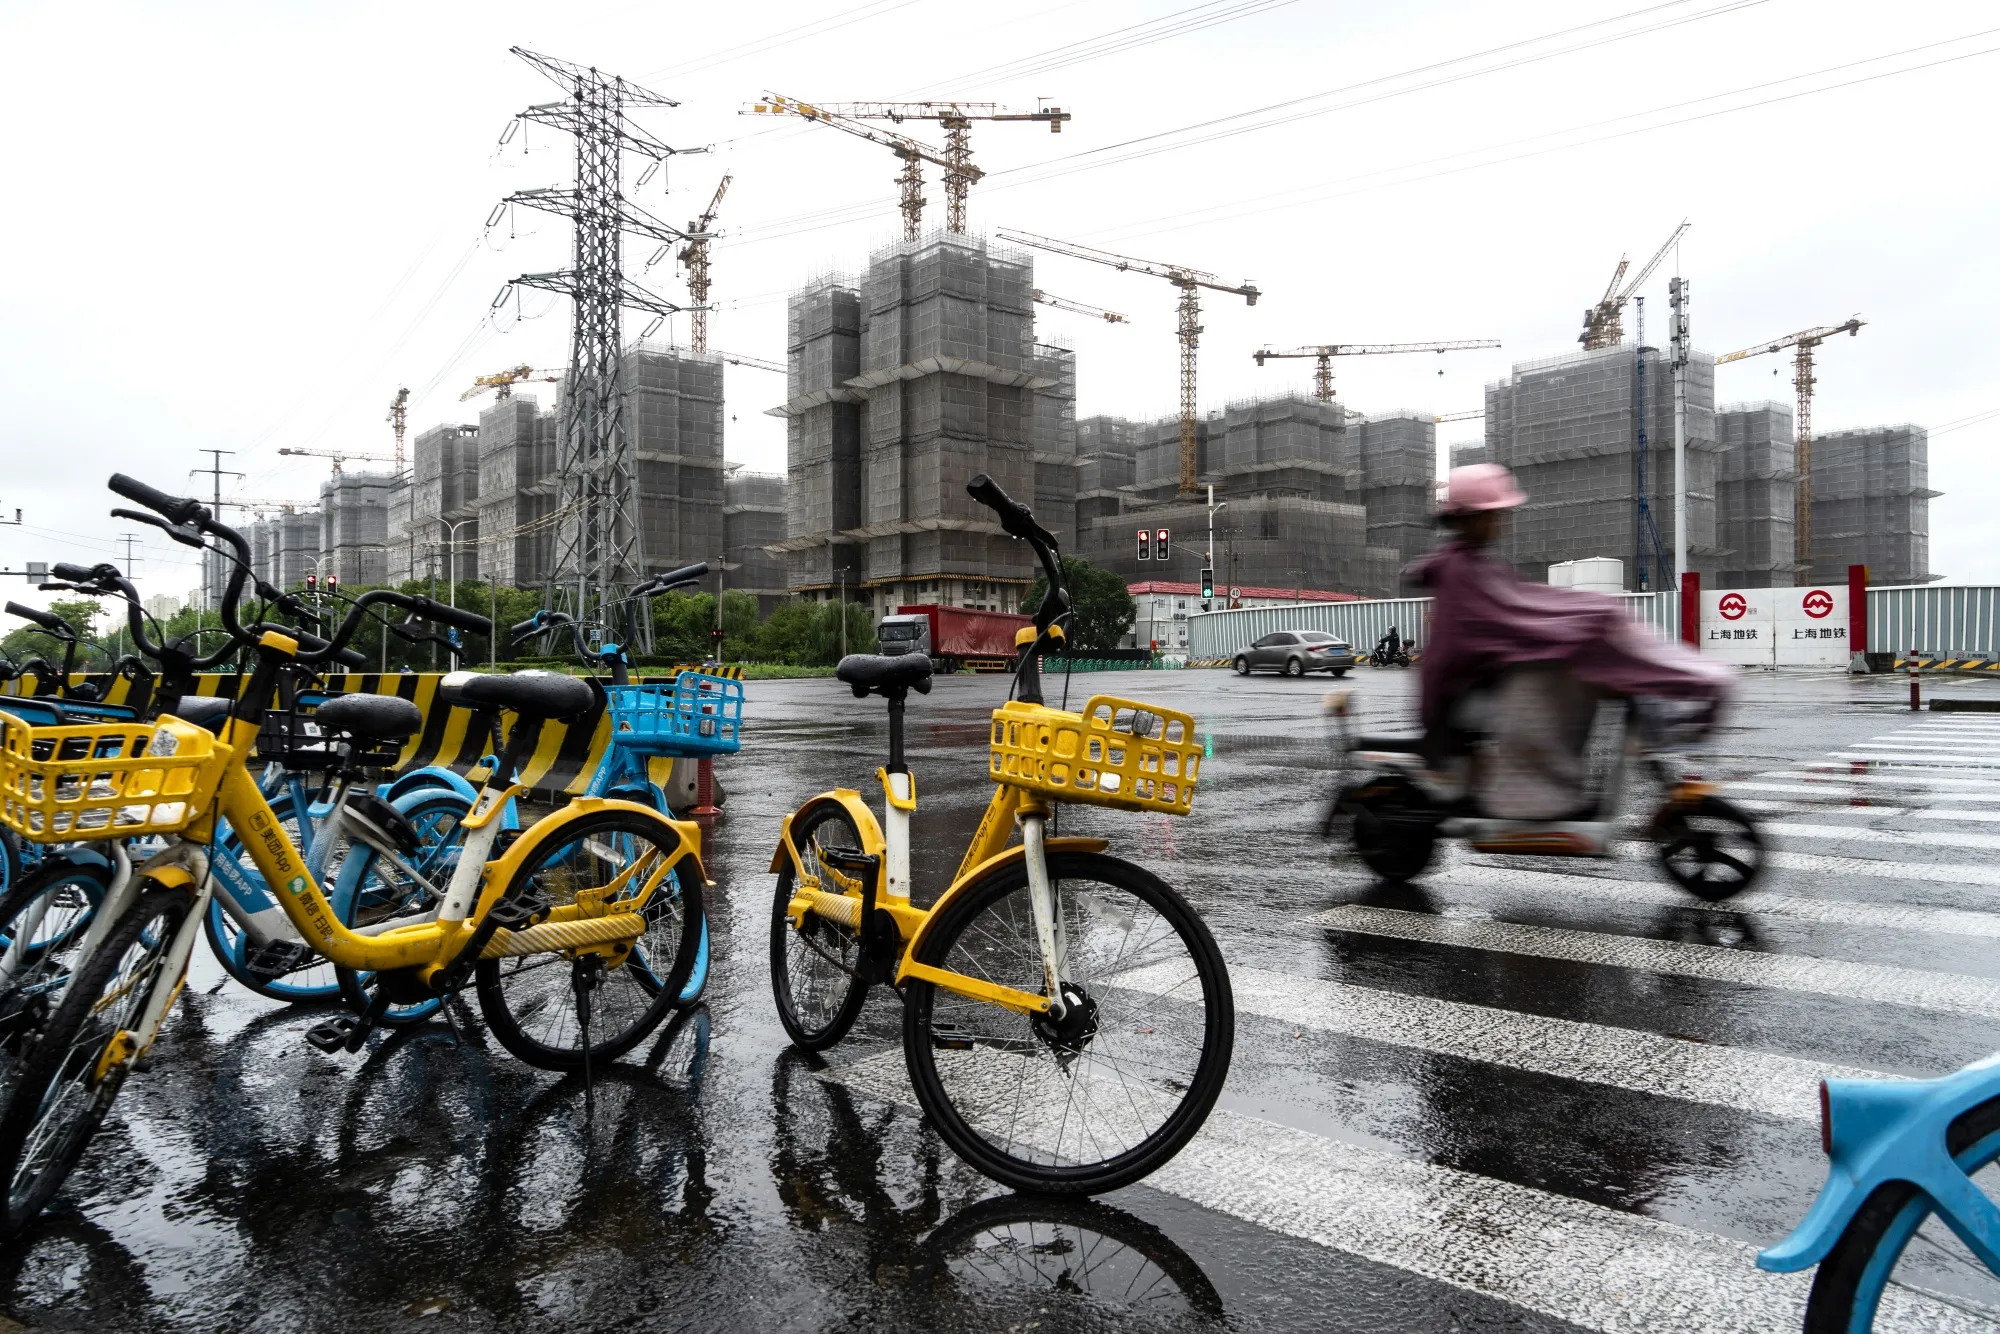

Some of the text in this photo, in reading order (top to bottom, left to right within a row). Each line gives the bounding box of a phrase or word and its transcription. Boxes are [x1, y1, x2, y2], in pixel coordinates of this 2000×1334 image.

[1231, 589, 1240, 597] 40
[1707, 629, 1758, 640] 上海地铁
[1792, 627, 1847, 639] 上海地铁
[260, 827, 335, 940] 美团App 微信 扫码
